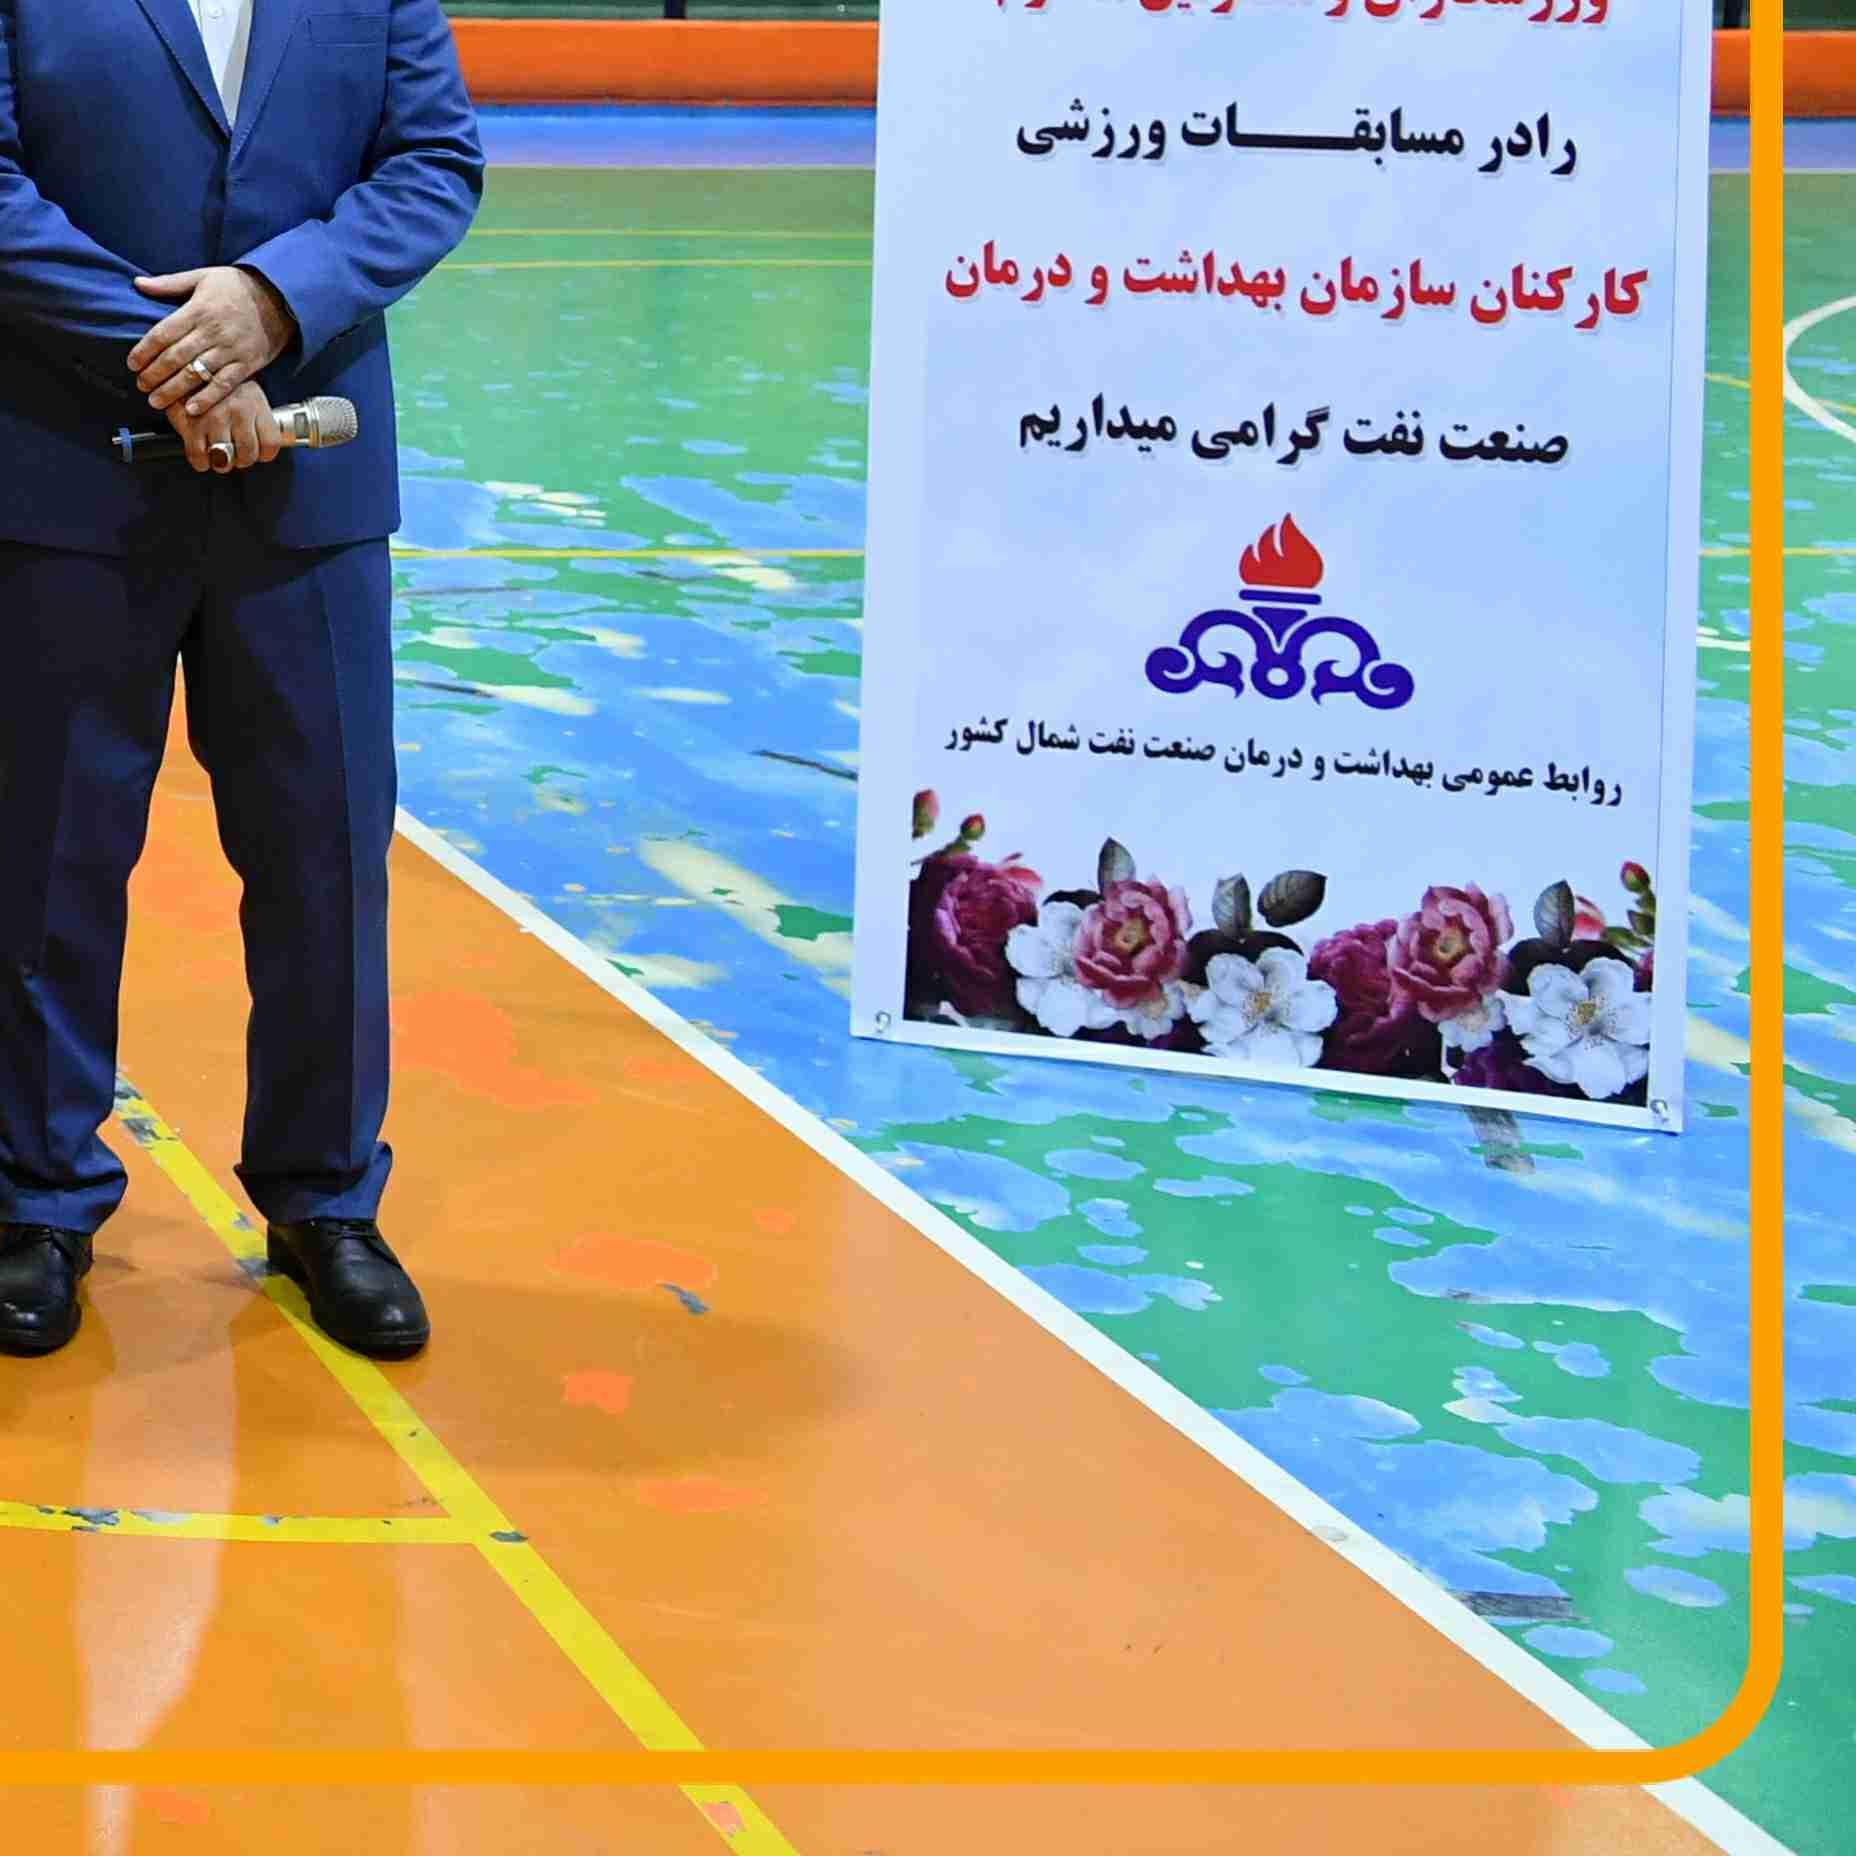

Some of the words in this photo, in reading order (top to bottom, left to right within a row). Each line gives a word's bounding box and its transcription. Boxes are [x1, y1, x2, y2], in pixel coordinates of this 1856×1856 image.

[1016, 98, 1166, 161] ورزشی
[945, 239, 1073, 302] درمان
[1086, 265, 1109, 305] و
[1123, 250, 1286, 311] بهداشت
[1300, 256, 1456, 320] سازمان
[1020, 393, 1177, 453] میداریم
[1191, 403, 1330, 465] گرامی
[1343, 410, 1425, 456] نفت
[1439, 424, 1569, 464] صنعت
[945, 717, 1009, 751] کشور
[1016, 720, 1080, 755] شمال
[1088, 732, 1135, 756] نفت
[1143, 737, 1216, 761] صنعت
[1224, 738, 1303, 778] درمان
[1311, 755, 1325, 781] و
[1334, 749, 1434, 786] بهداشت
[1442, 767, 1534, 796] عمومی
[1543, 762, 1622, 807] روابط
